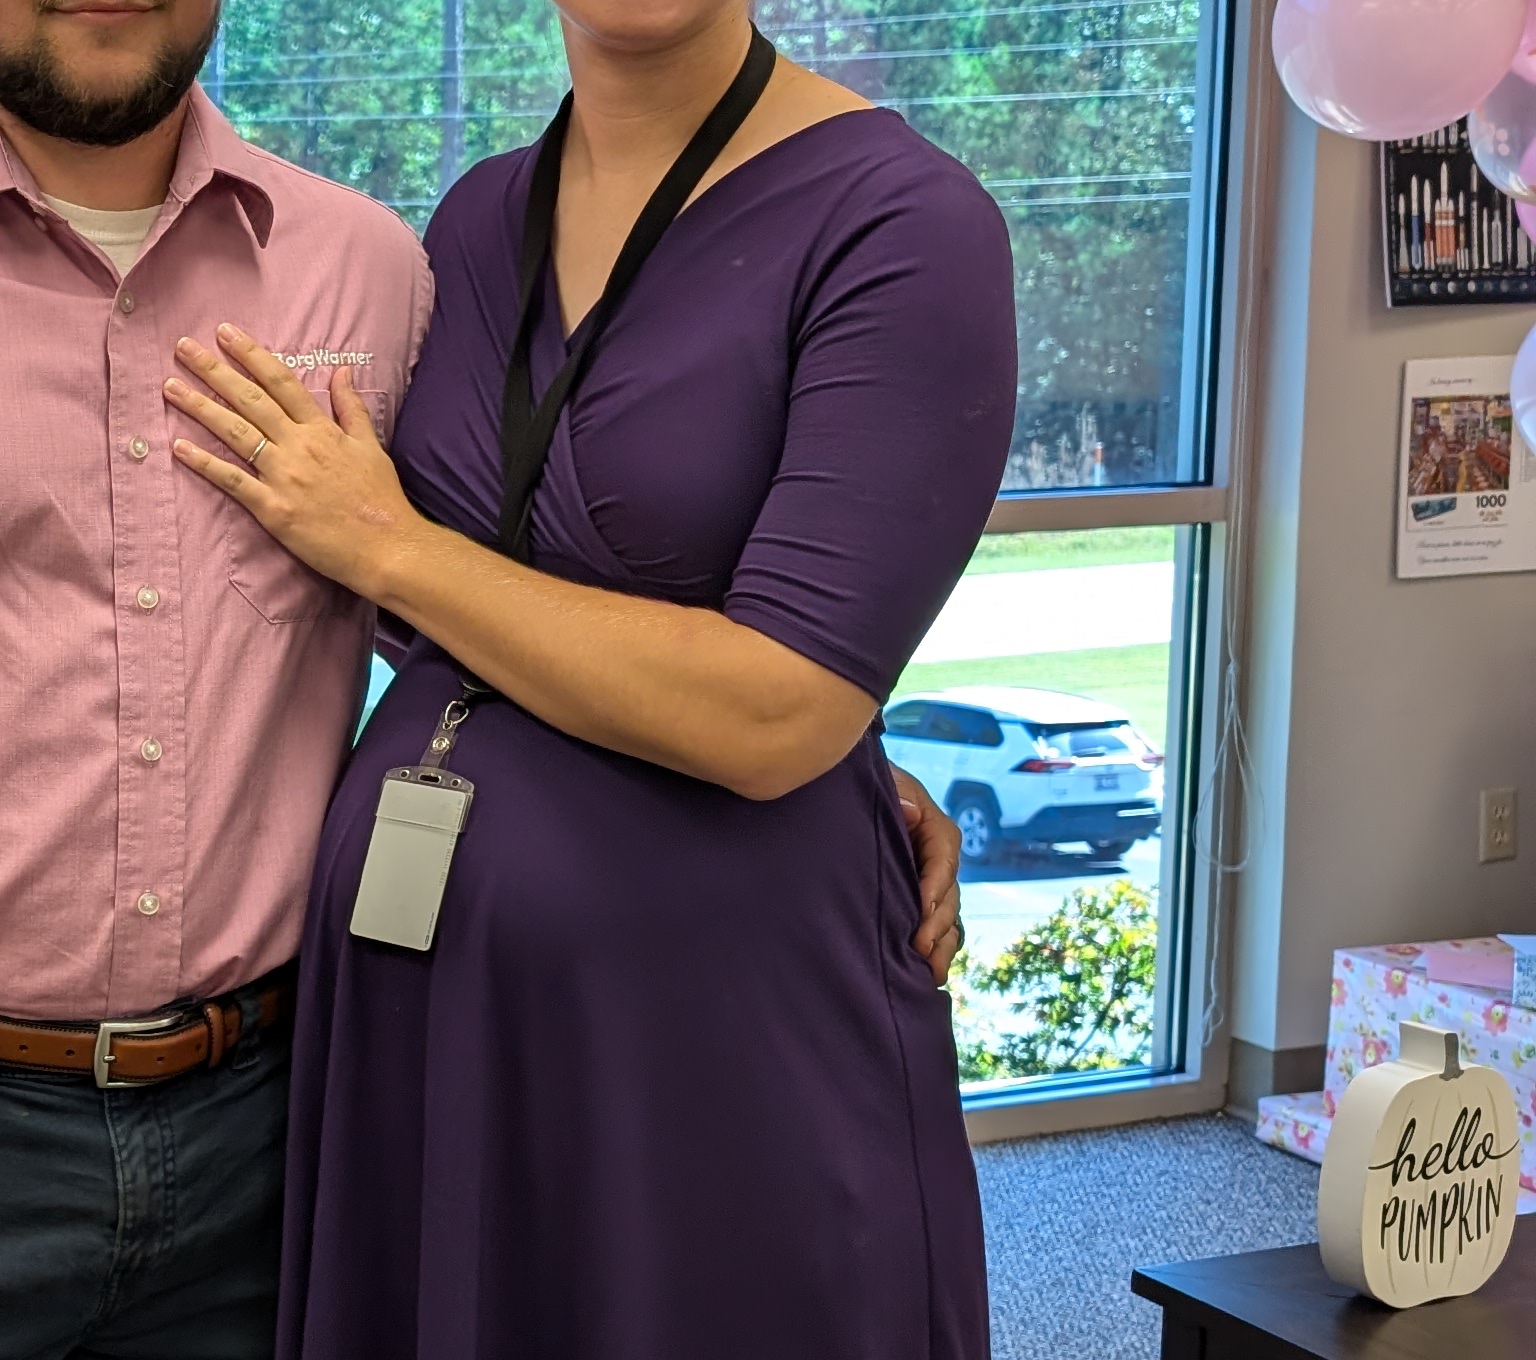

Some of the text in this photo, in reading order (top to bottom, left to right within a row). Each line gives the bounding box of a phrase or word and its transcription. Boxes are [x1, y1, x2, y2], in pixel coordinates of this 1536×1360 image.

[1475, 494, 1507, 509] 1000
[1368, 1107, 1521, 1187] hello
[1380, 1174, 1503, 1264] PUMPKIN
